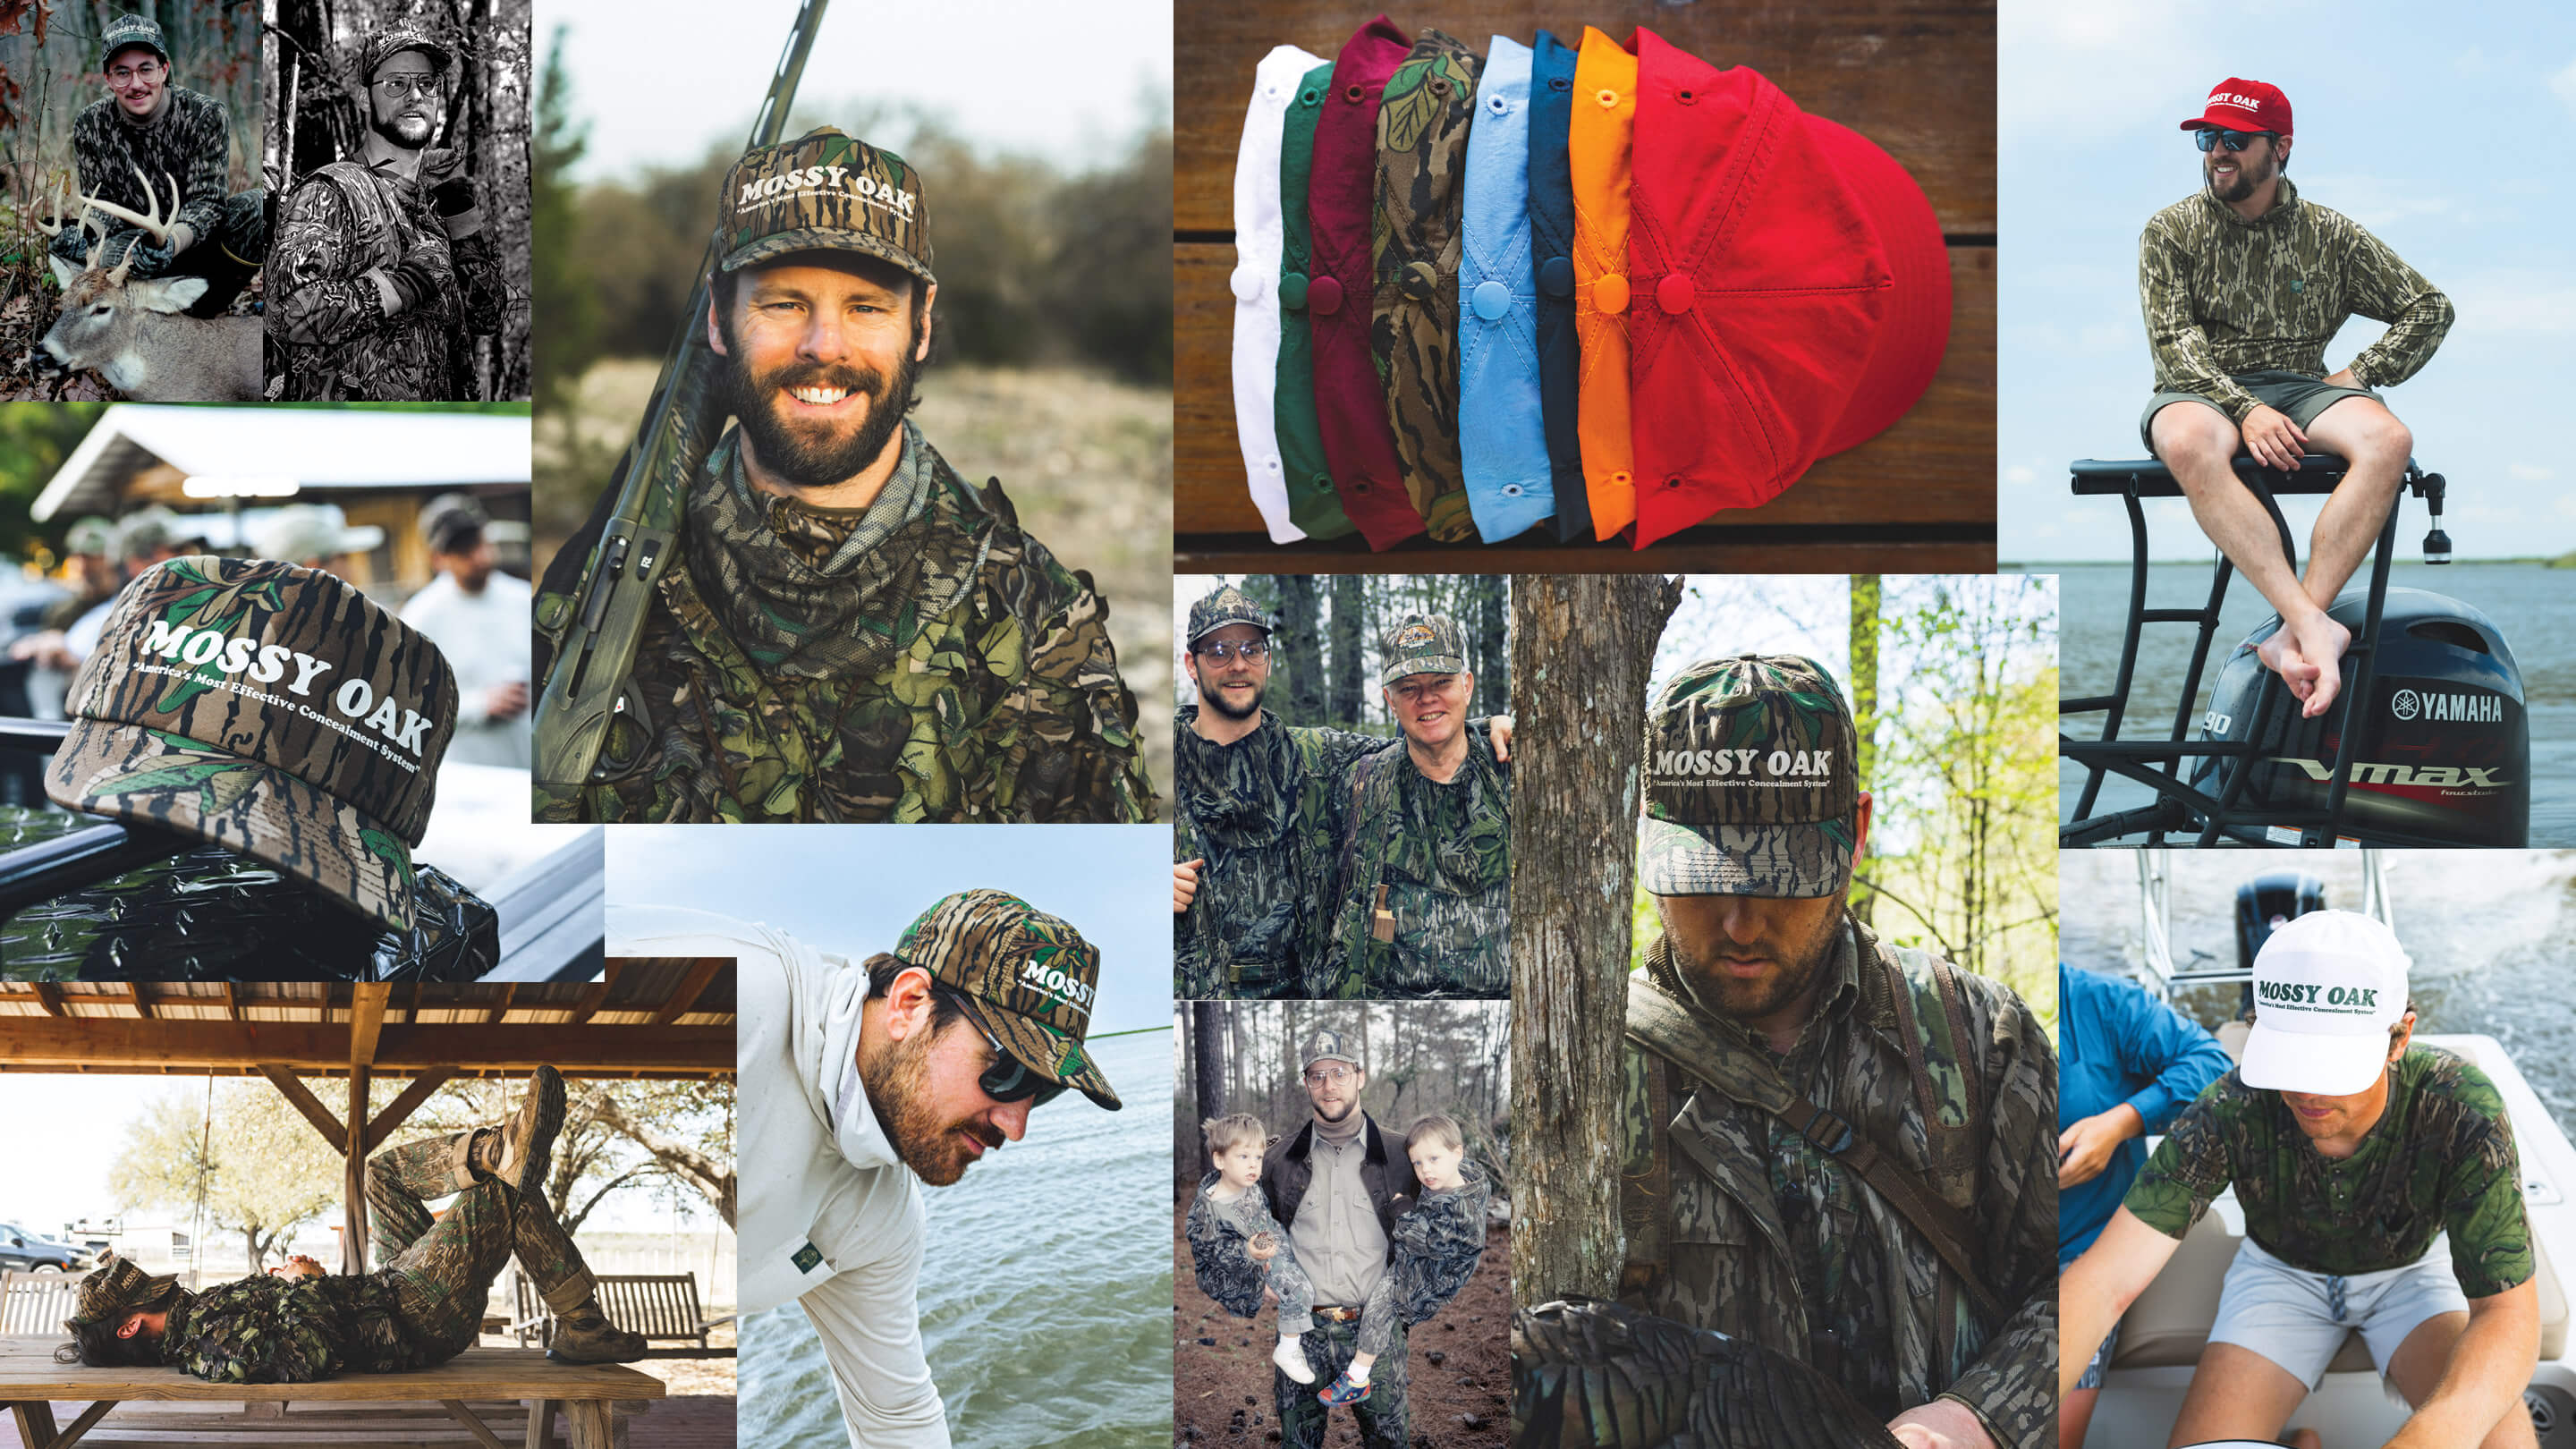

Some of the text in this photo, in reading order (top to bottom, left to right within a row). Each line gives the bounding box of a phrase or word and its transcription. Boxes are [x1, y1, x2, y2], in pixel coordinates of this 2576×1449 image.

[137, 26, 157, 34] OAK
[2233, 94, 2260, 109] OAK
[738, 165, 914, 215] MOSSY OAK
[141, 619, 433, 758] MOSSY OAK
[193, 673, 227, 690] Most
[229, 681, 296, 712] Effective
[299, 705, 380, 750] Concealment
[2422, 692, 2503, 723] YAMAHA
[1655, 749, 1833, 776] MOSSY OAK
[1706, 779, 1747, 787] Effective
[1748, 779, 1802, 787] Concealment
[2258, 980, 2377, 1007] MOSSY OAK
[2286, 1004, 2312, 1012] Effective
[2313, 1006, 2353, 1014] Concealment
